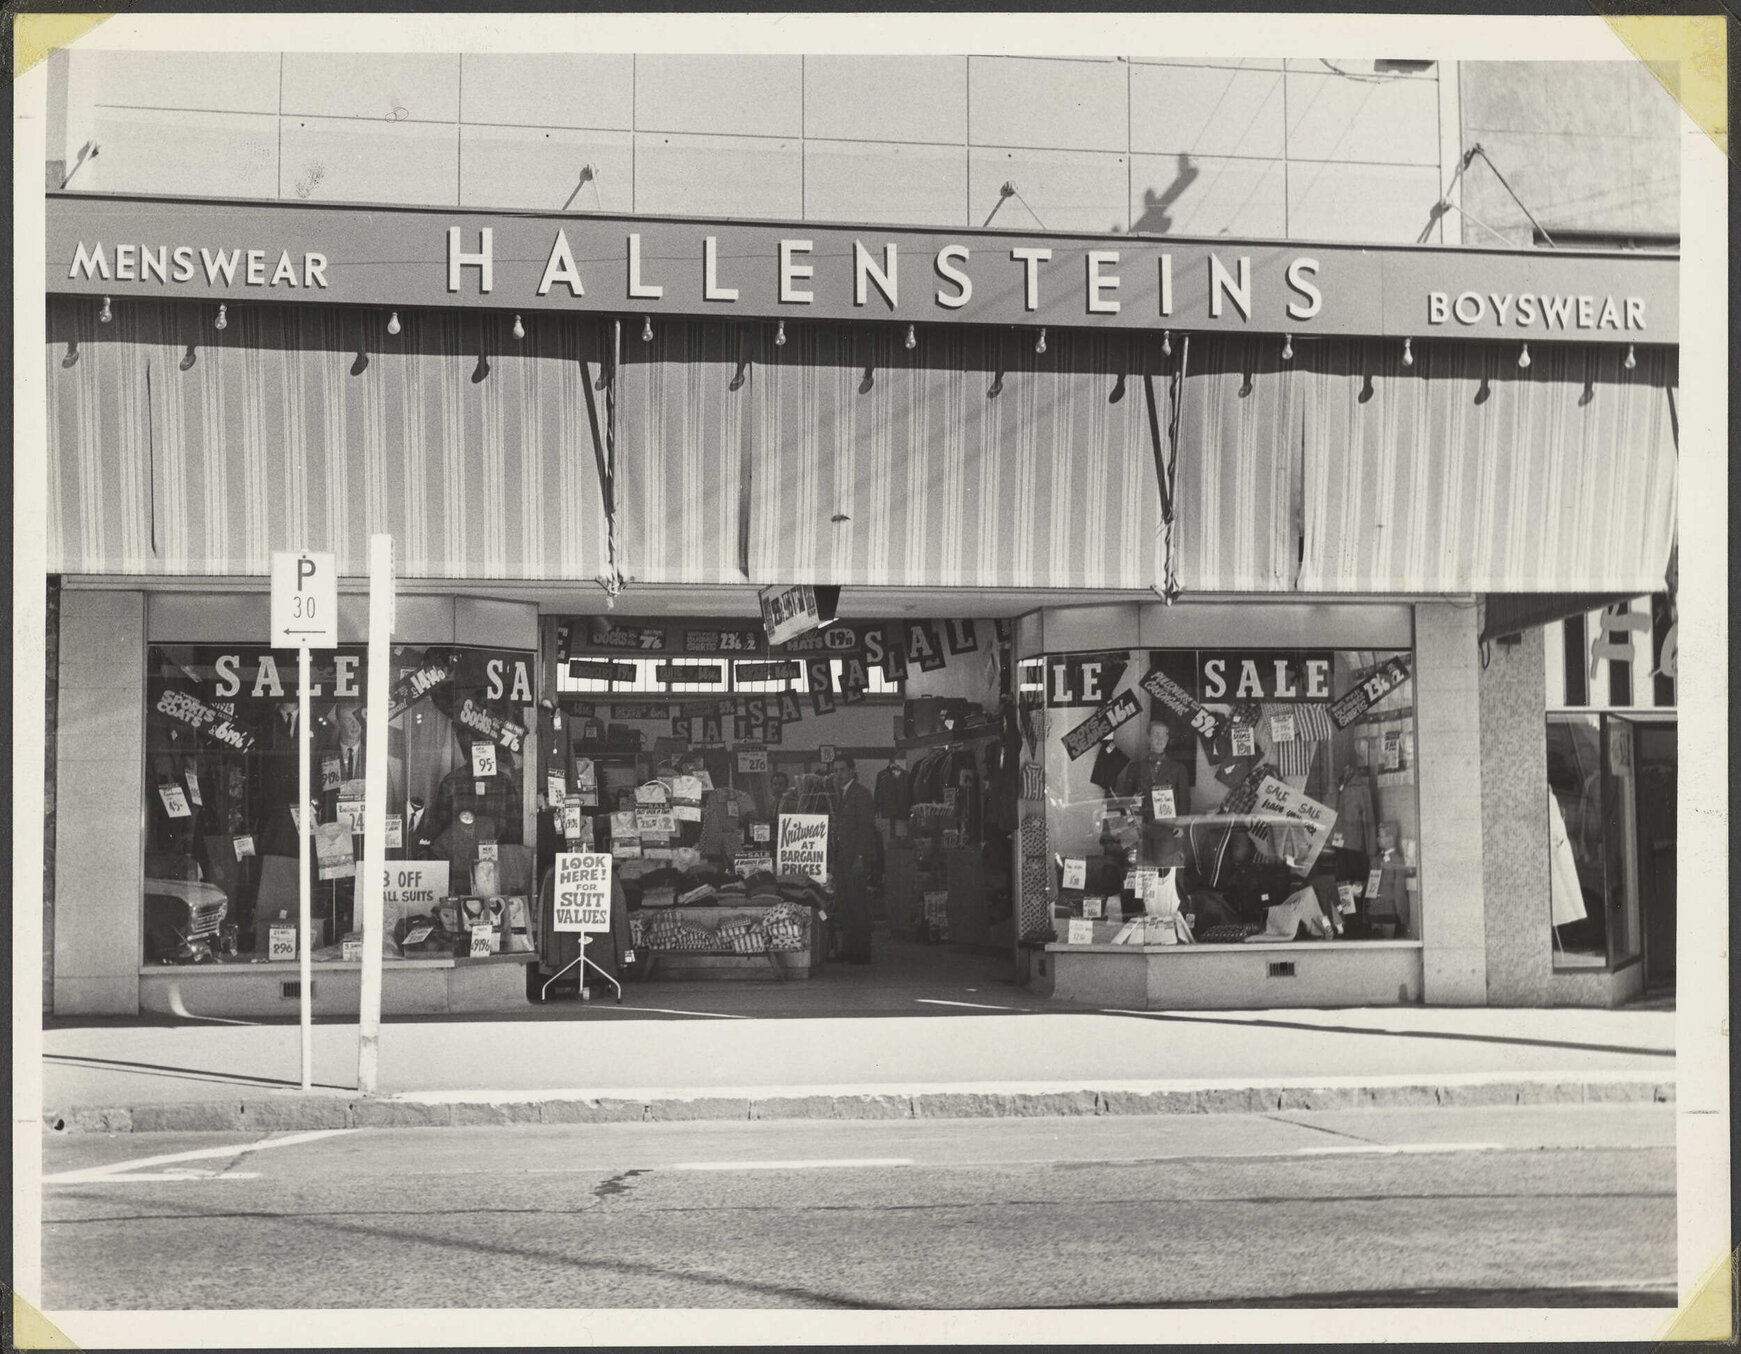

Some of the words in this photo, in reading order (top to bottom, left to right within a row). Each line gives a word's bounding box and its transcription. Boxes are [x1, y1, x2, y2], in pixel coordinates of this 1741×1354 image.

[69, 240, 329, 288] MENSWEAR
[446, 226, 1324, 322] HALLENSTEINS
[1429, 291, 1647, 331] BOYSWEAR
[297, 558, 316, 591] P
[293, 596, 316, 619] 30
[487, 659, 532, 702] SA
[1053, 663, 1102, 702] LE
[1205, 659, 1329, 698] SALE
[156, 701, 204, 728] COATS
[161, 689, 216, 723] SPORTS
[460, 699, 492, 735] Socks
[1067, 716, 1100, 748] BOYS
[1071, 720, 1111, 757] JEANS
[1264, 784, 1290, 803] SALE
[1297, 802, 1321, 820] SALE
[780, 817, 827, 849] Knitwear
[800, 841, 815, 850] AT
[561, 855, 606, 871] LOOK
[780, 850, 824, 863] BARGAIN
[781, 863, 822, 876] PRICES
[398, 870, 423, 888] OFF
[559, 868, 607, 884] HERE!
[576, 883, 598, 891] FOR
[401, 889, 434, 903] SUITS
[560, 891, 605, 908] SUIT
[555, 908, 607, 924] VALUES
